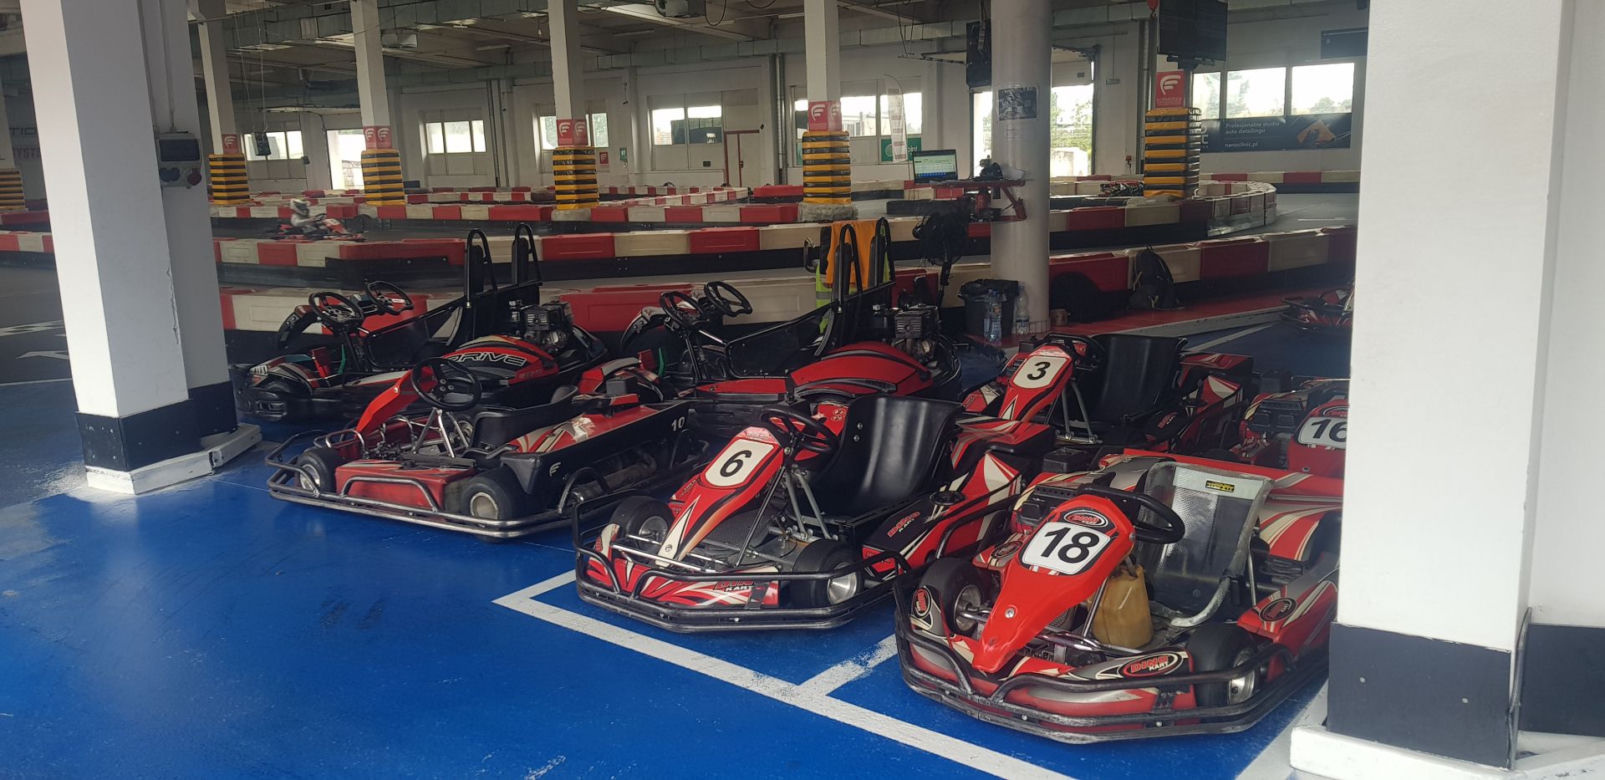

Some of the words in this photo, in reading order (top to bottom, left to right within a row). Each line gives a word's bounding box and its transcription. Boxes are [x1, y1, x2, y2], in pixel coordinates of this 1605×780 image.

[1027, 361, 1051, 381] 3
[671, 416, 685, 431] 10
[1311, 418, 1348, 443] 16
[720, 450, 752, 477] 6
[1040, 527, 1099, 563] 18
[1130, 655, 1169, 673] DINO
[1149, 661, 1169, 671] KART
